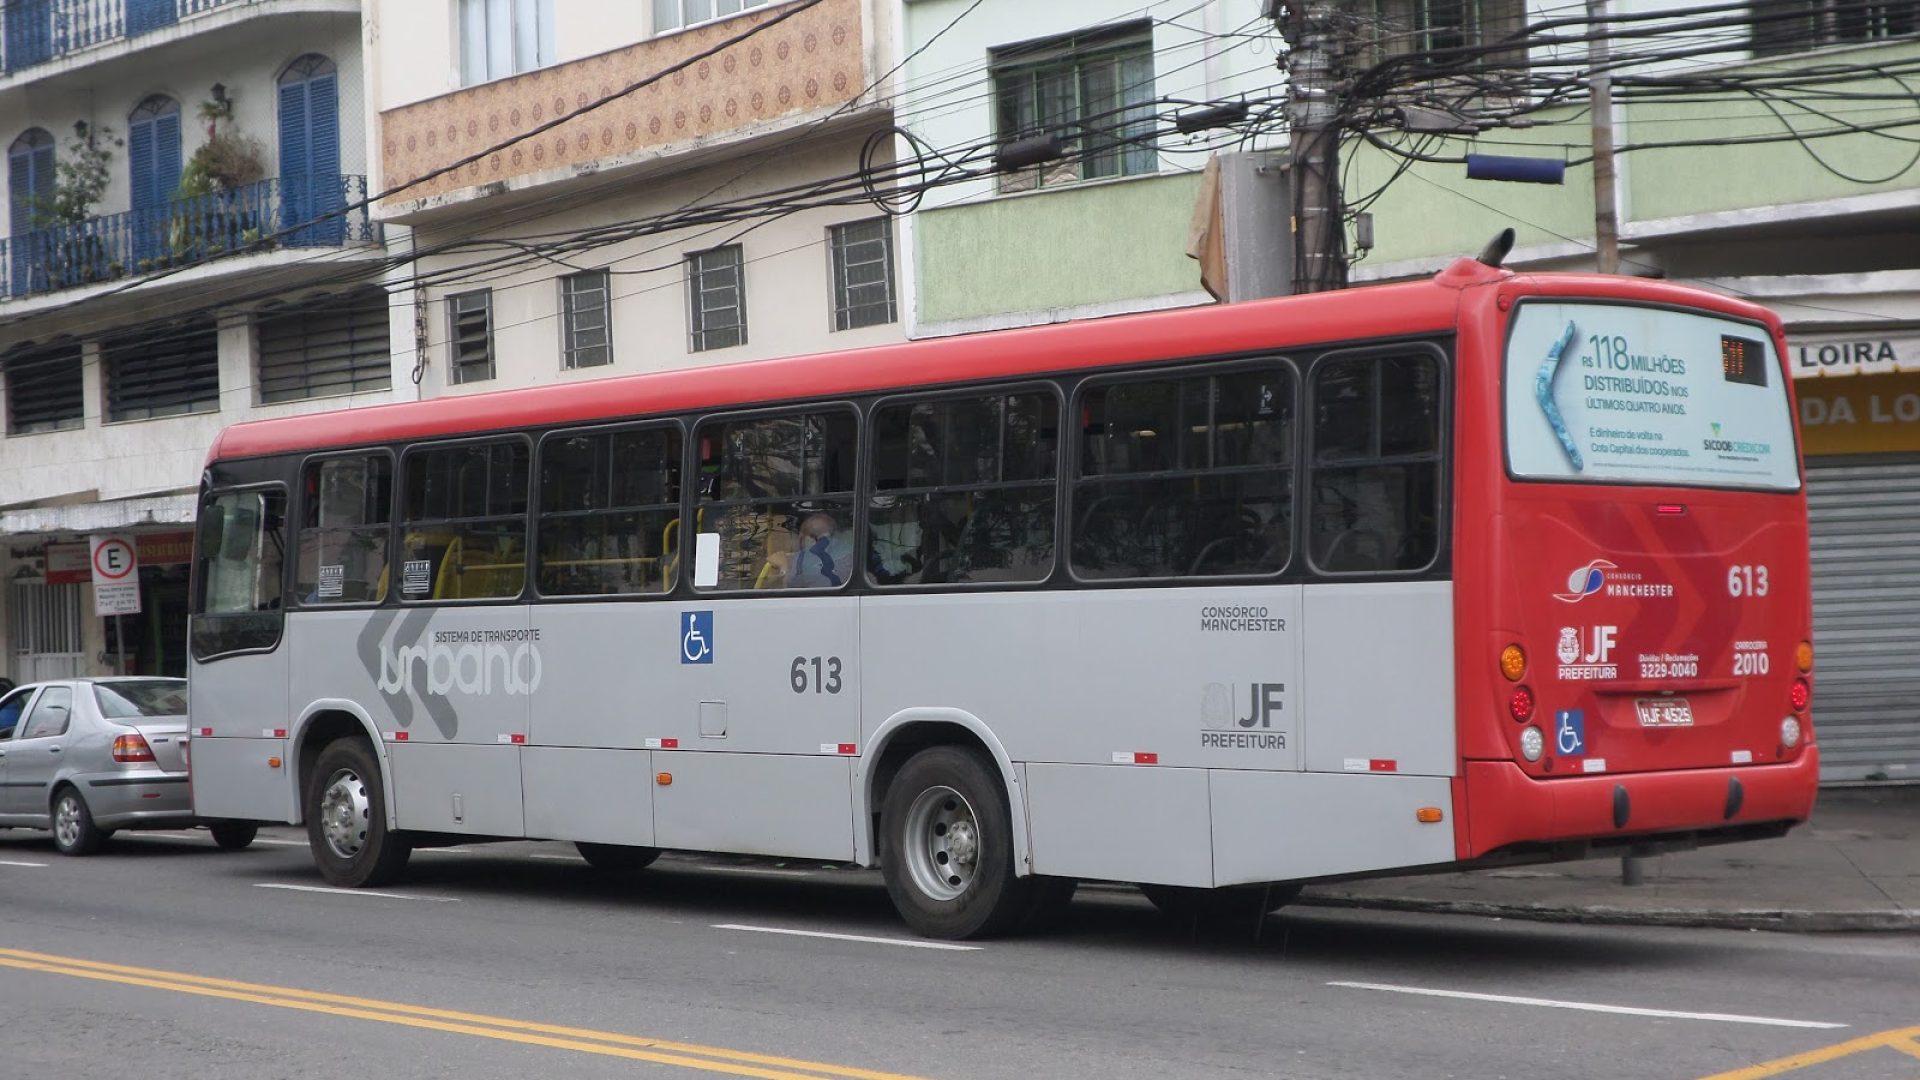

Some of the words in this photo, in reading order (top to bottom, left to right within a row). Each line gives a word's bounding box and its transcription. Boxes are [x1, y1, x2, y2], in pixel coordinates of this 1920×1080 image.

[1582, 356, 1593, 368] R$
[1590, 335, 1629, 371] 118
[1631, 354, 1685, 374] MILHÕES
[1801, 341, 1897, 367] LOIRA
[1584, 375, 1669, 396] DISTRIBUÍDOS
[1671, 385, 1688, 398] NOS
[1586, 396, 1625, 411] ÚLTIMOS
[1626, 400, 1661, 413] QUATRO
[1661, 402, 1687, 415] ANOS.
[1802, 396, 1856, 425] DA
[1871, 394, 1920, 423] LO
[108, 549, 121, 569] E
[1607, 585, 1673, 597] MANCHESTER
[1728, 565, 1768, 597] 613
[1202, 604, 1268, 618] CONSÓRCIO
[435, 630, 469, 643] SISTEMA
[471, 630, 483, 642] DE
[484, 628, 540, 642] TRANSPORTE
[1201, 619, 1286, 632] MANCHESTER
[1585, 626, 1617, 663] JF
[378, 631, 542, 695] urbano
[1559, 667, 1617, 680] PREFEITURA
[1641, 663, 1698, 678] 3229-0040
[1733, 653, 1769, 675] 2010
[790, 656, 842, 694] 613
[1238, 683, 1285, 728] JF
[1202, 733, 1286, 749] PREFEITURA
